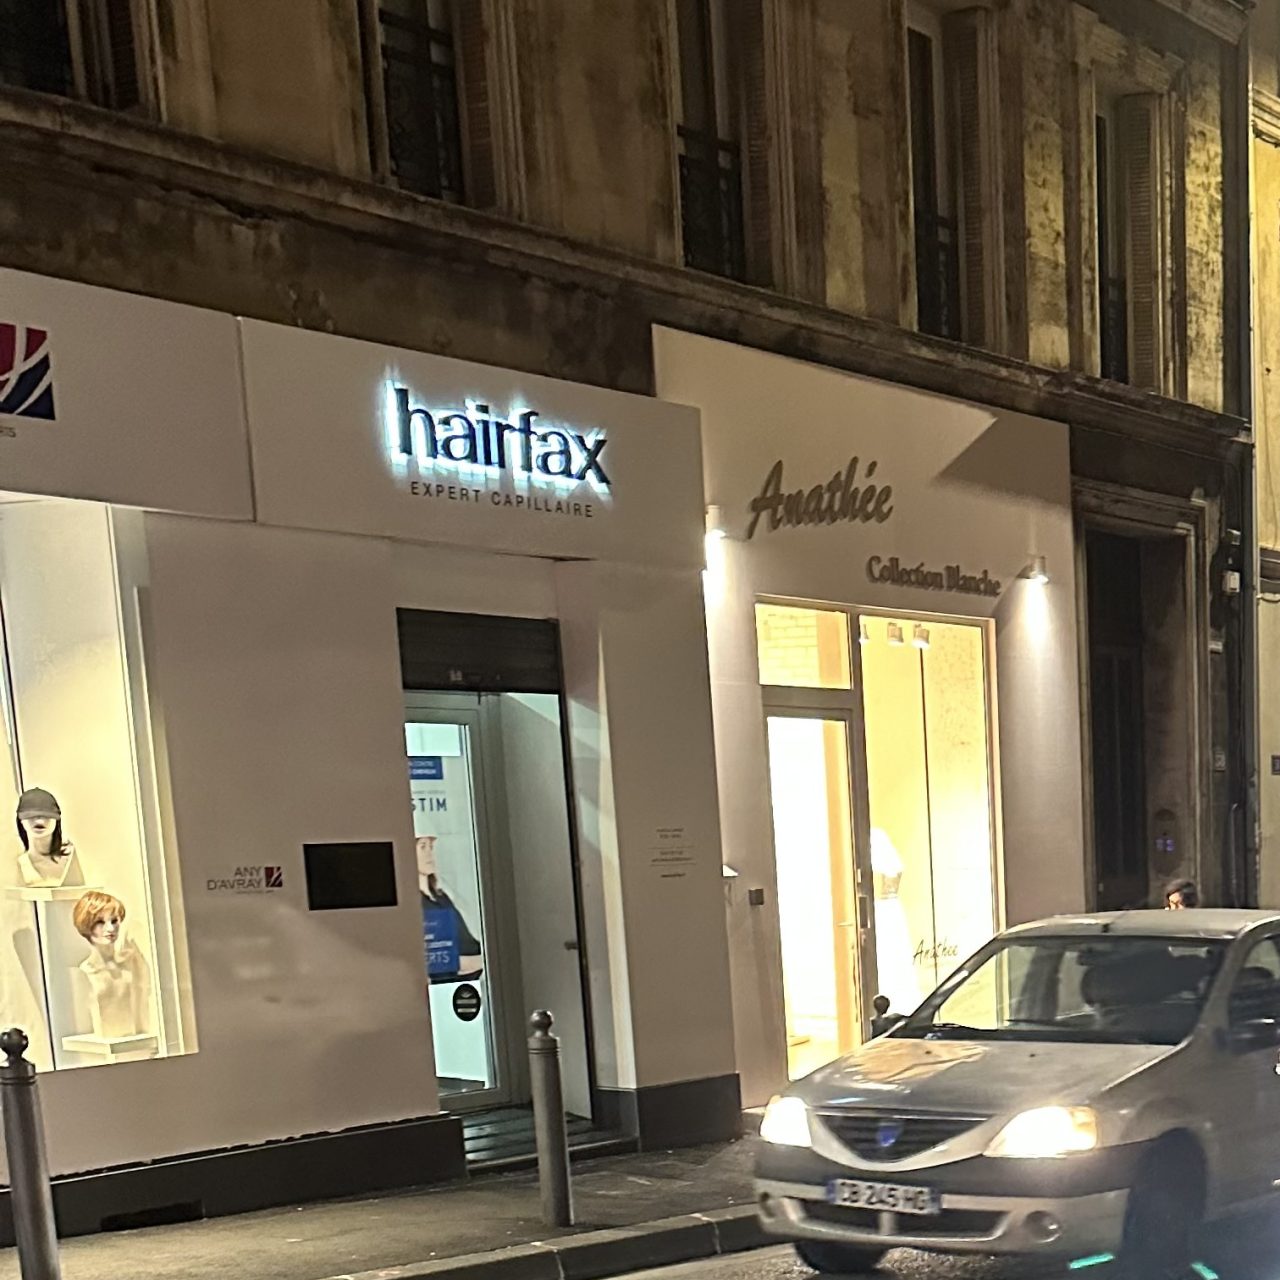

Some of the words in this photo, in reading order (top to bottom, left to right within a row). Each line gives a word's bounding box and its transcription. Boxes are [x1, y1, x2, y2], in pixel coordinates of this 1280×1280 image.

[393, 386, 611, 486] hairfax
[410, 481, 481, 503] EXPERT
[490, 492, 594, 518] CAPILLAIRE
[747, 455, 894, 541] Anathée
[866, 554, 944, 591] Collection
[945, 564, 1002, 597] Blanche
[206, 878, 263, 891] D'AVRAY
[234, 866, 262, 877] ANY
